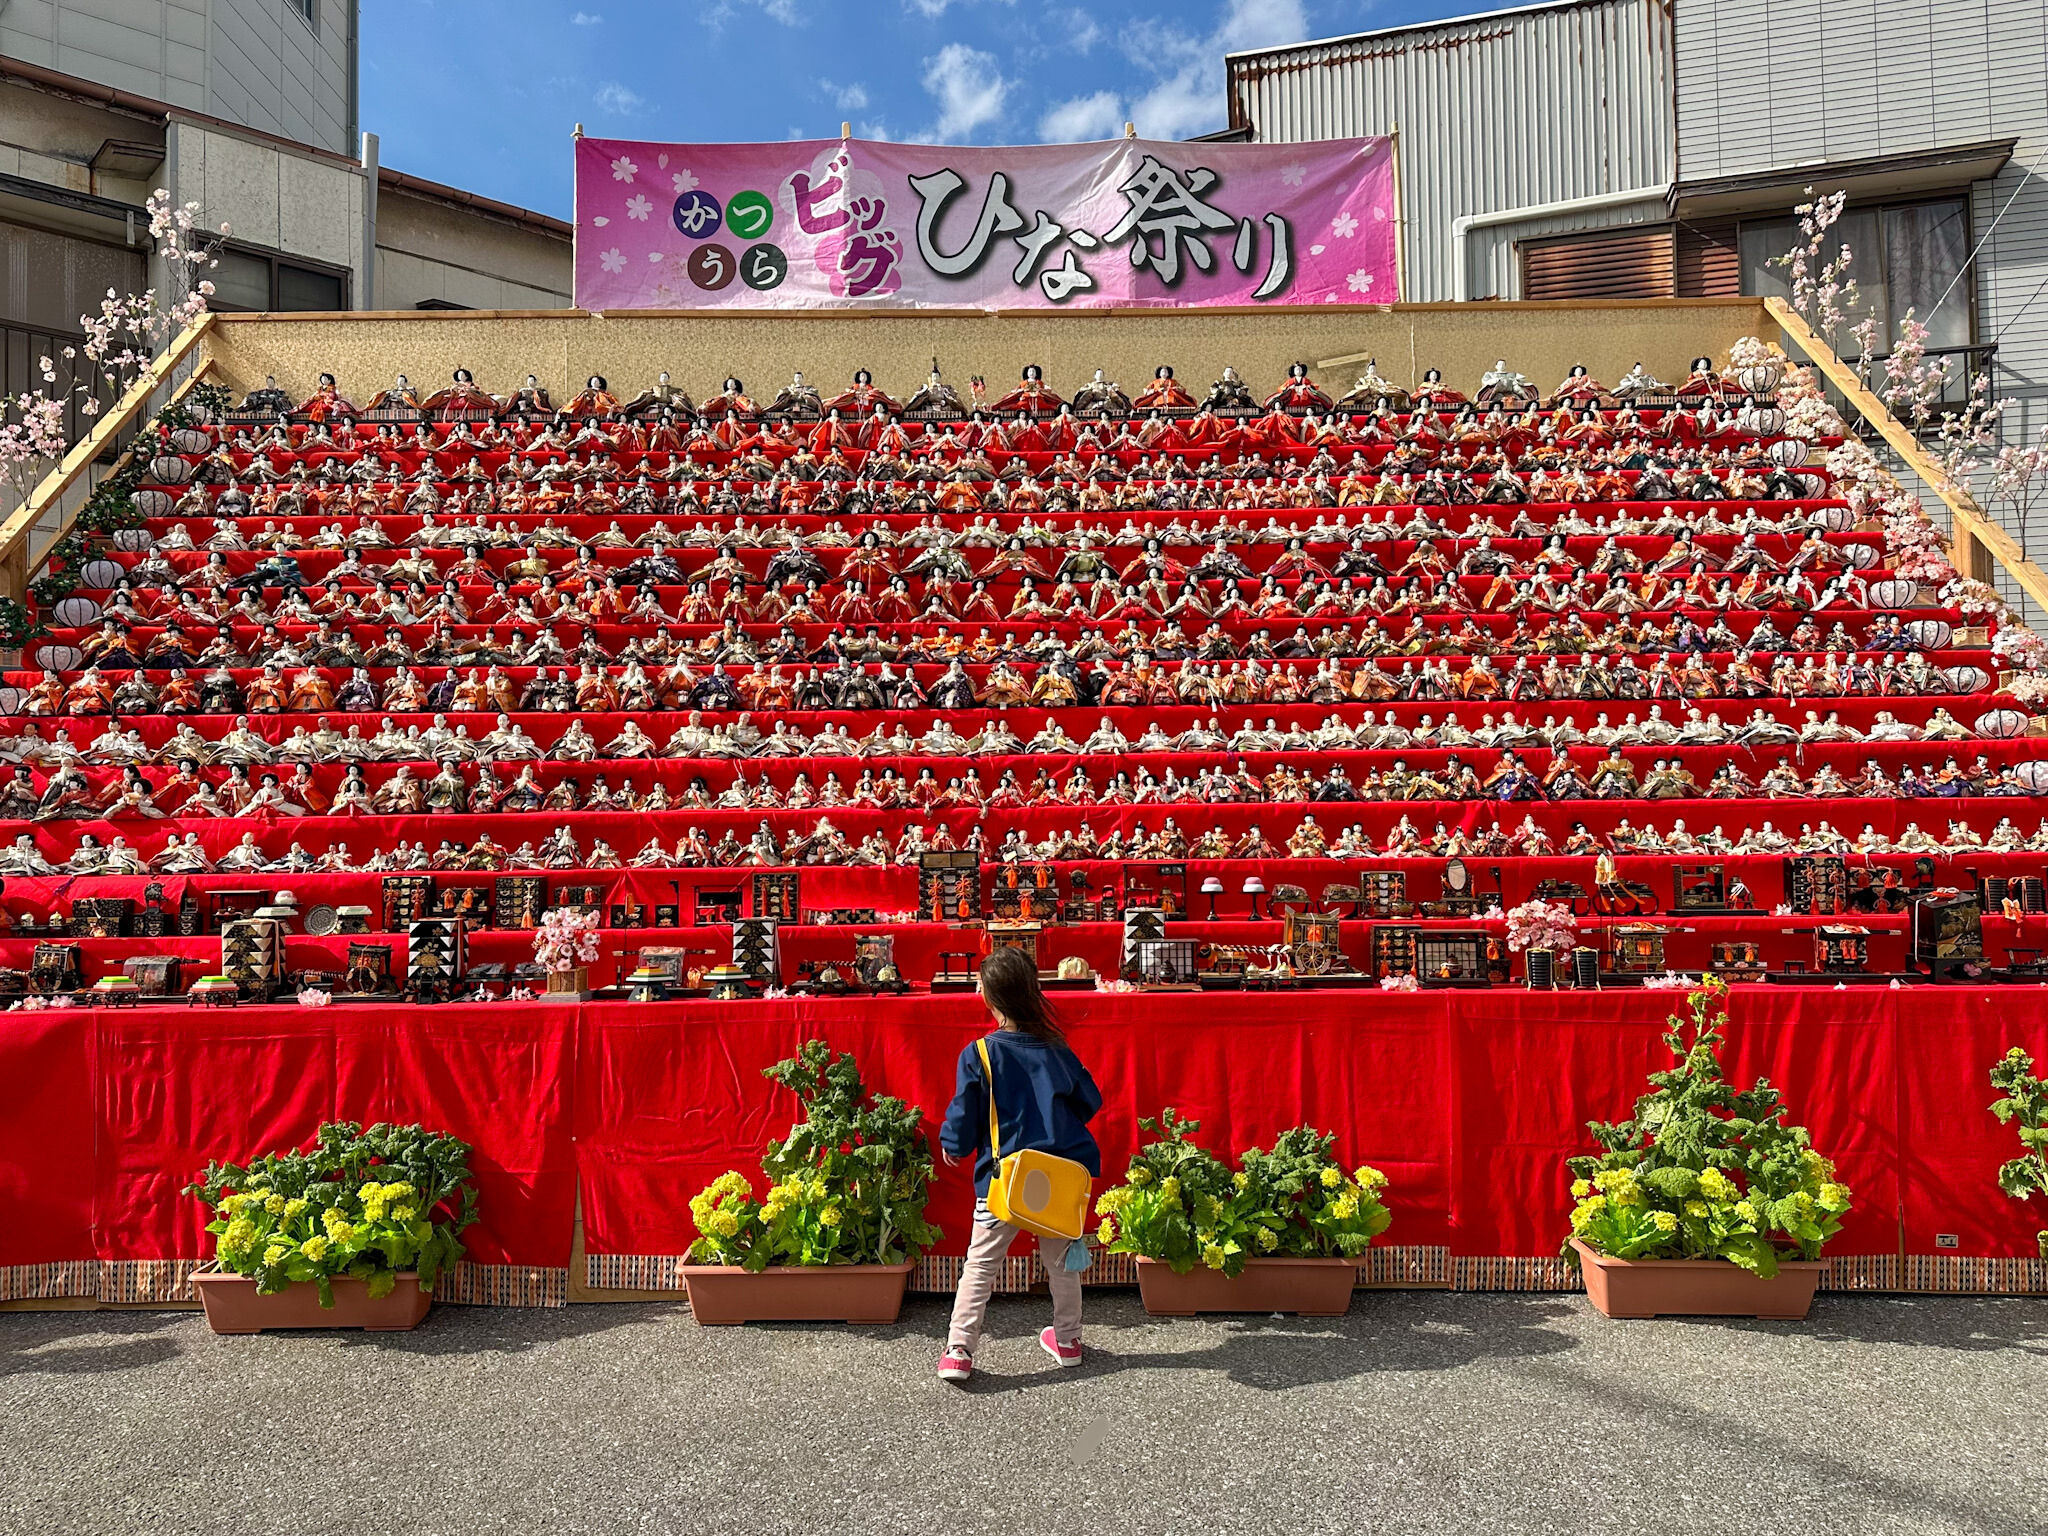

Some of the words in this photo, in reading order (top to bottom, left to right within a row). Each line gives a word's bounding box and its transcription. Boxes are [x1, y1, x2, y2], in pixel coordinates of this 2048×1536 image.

[789, 154, 897, 298] ビッグ
[908, 154, 1290, 300] ひな祭り
